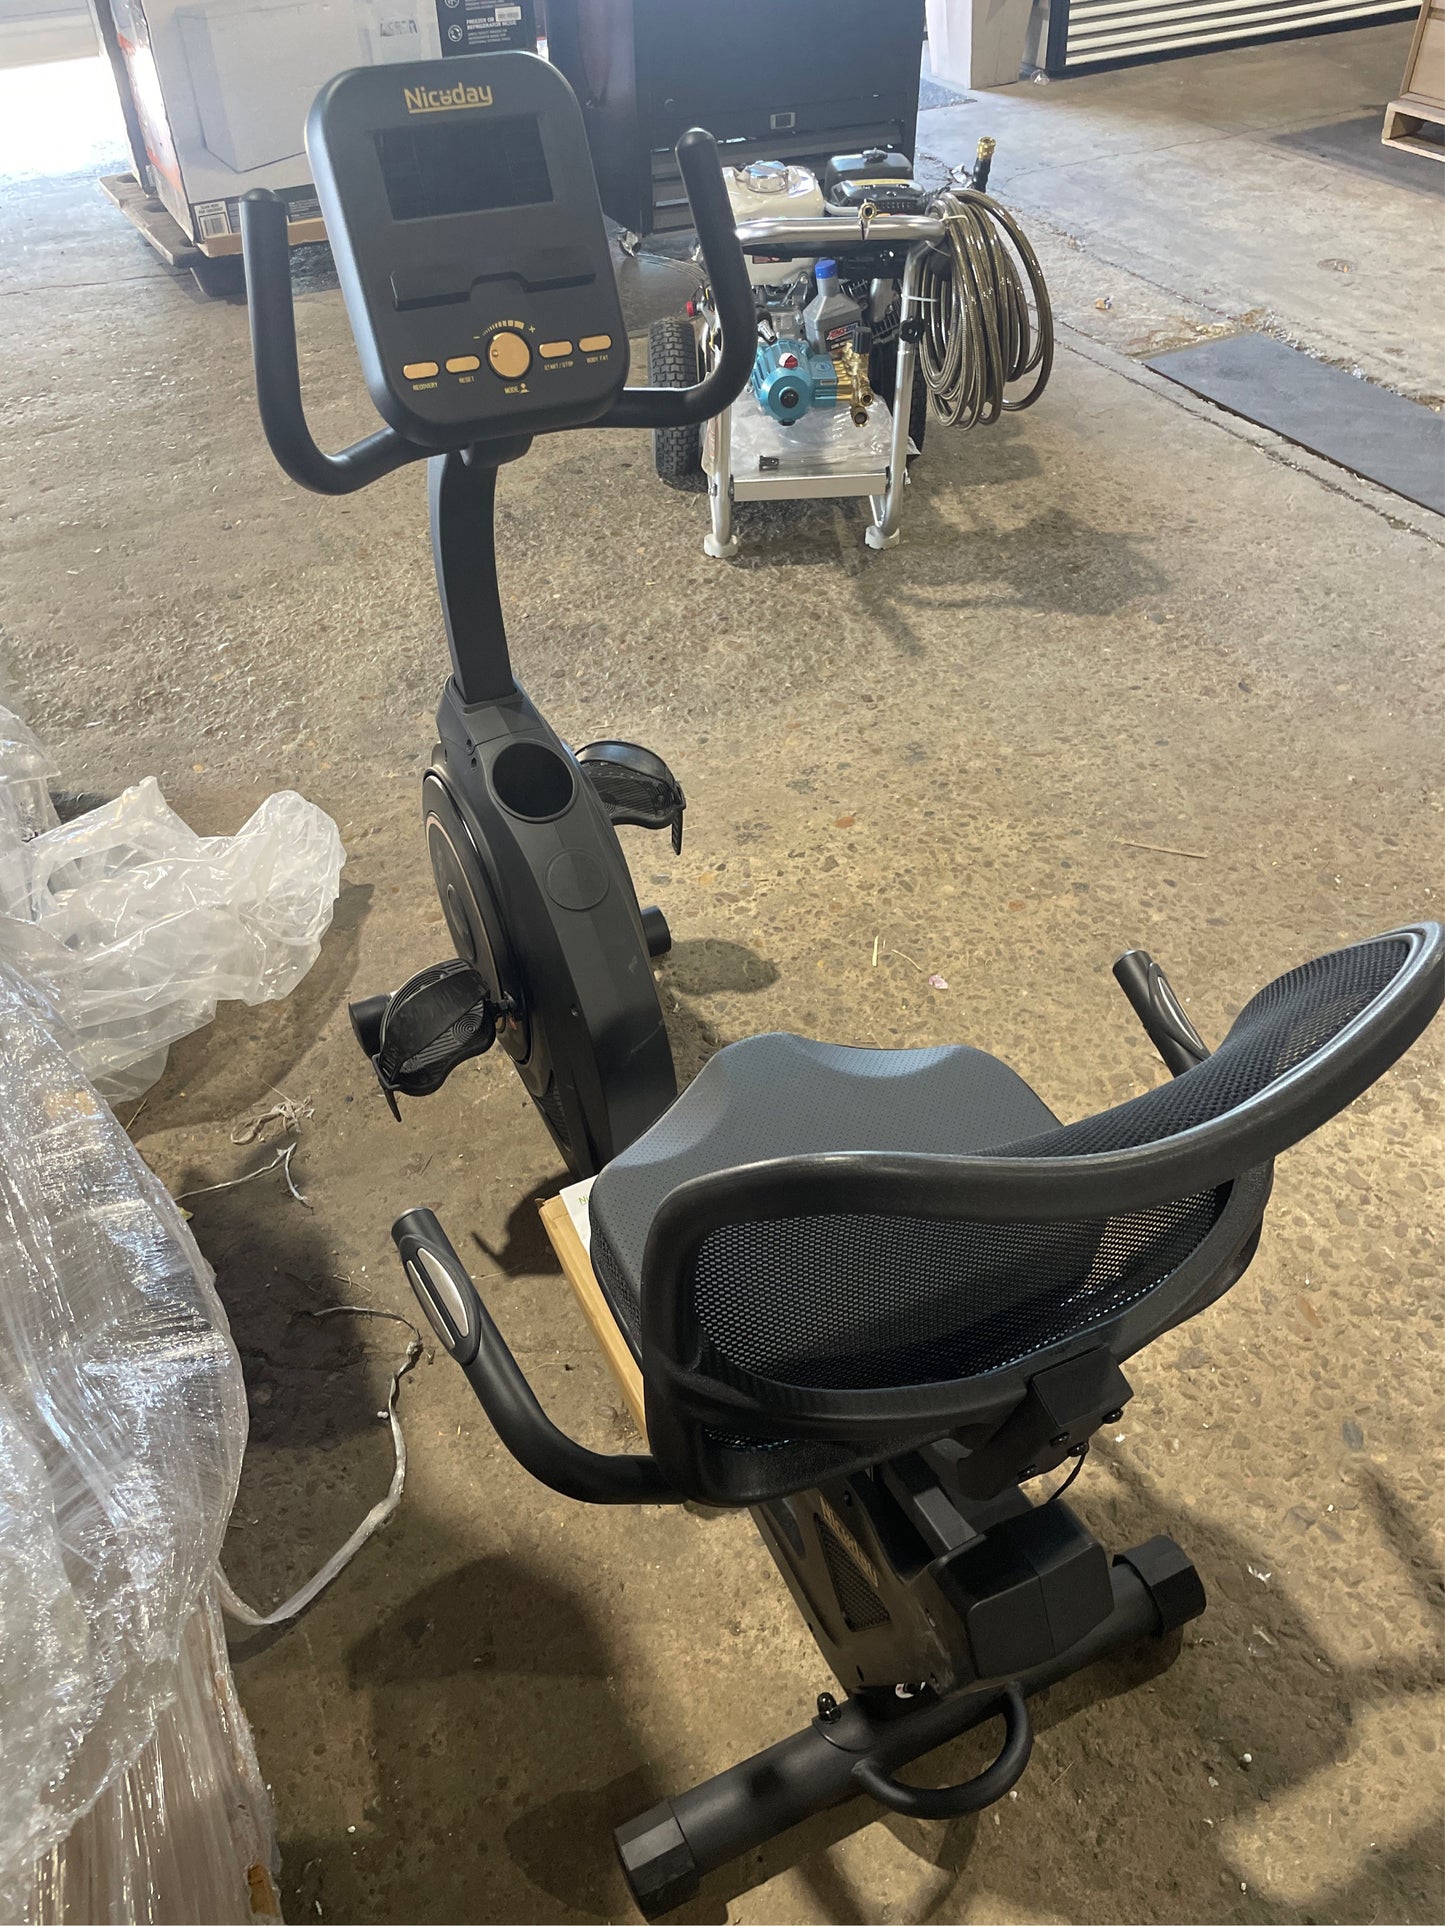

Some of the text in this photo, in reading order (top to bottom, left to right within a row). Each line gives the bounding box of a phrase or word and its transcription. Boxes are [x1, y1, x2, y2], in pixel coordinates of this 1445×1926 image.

[458, 375, 475, 384] RESET
[412, 382, 438, 391] RECOVERY
[504, 386, 519, 394] MODE
